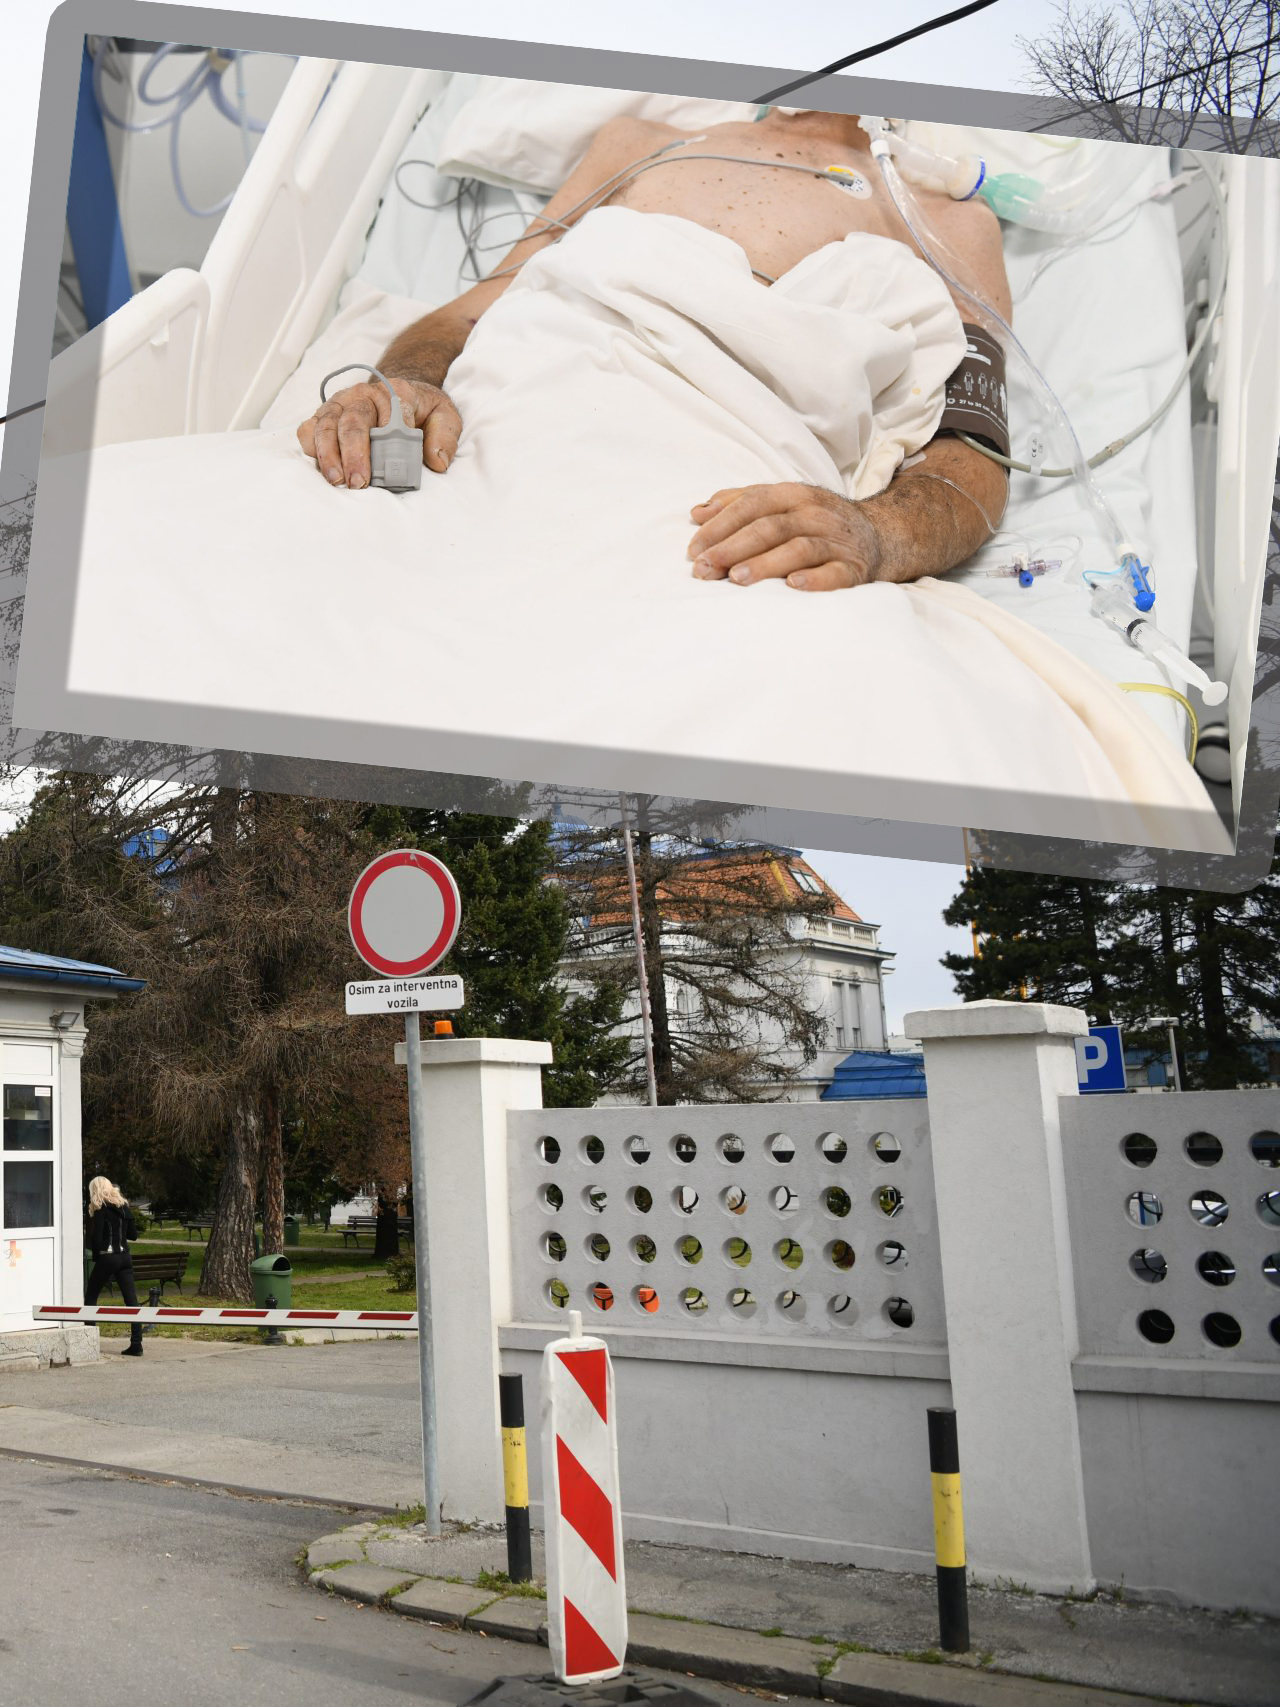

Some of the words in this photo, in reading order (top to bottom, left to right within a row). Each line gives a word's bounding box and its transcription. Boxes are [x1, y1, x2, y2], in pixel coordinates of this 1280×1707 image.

[348, 984, 375, 996] Osim
[378, 984, 391, 994] za
[393, 979, 458, 993] interventna
[387, 997, 419, 1009] vozila
[1074, 1036, 1108, 1083] P
